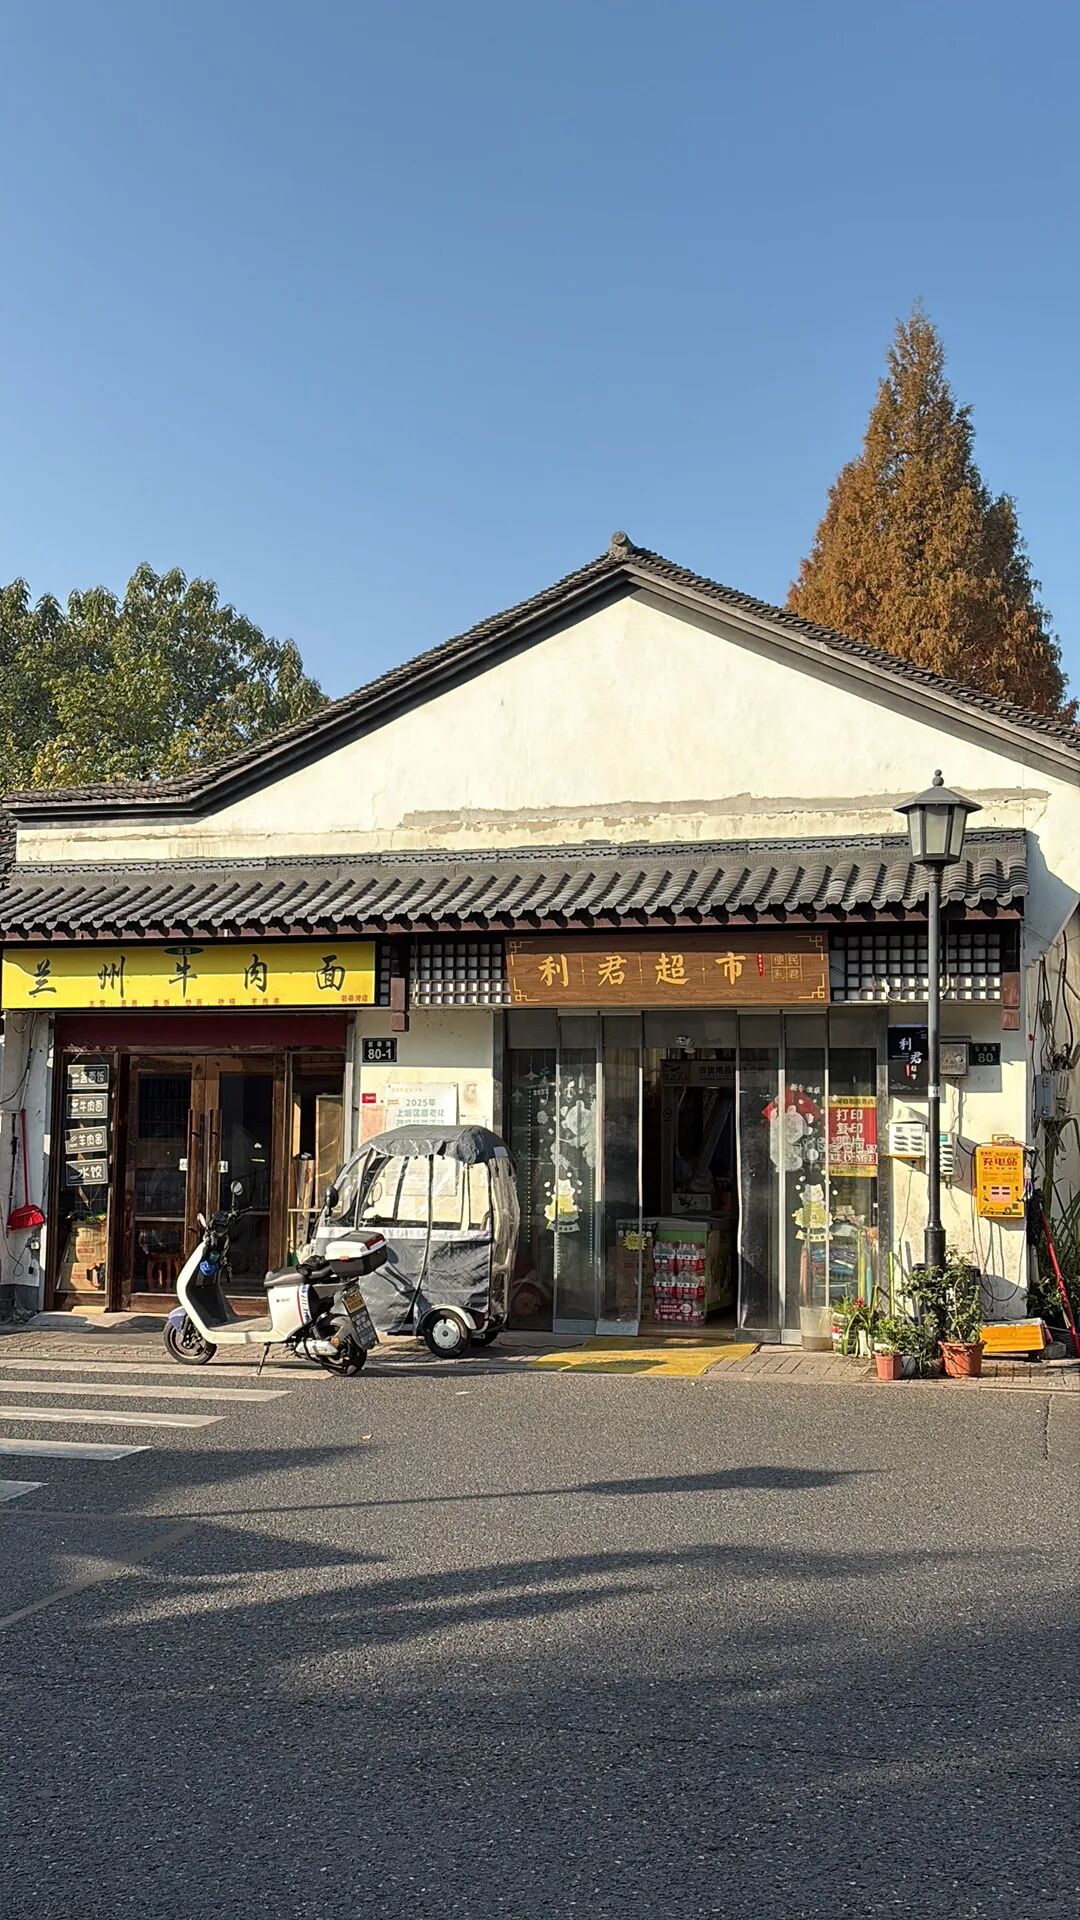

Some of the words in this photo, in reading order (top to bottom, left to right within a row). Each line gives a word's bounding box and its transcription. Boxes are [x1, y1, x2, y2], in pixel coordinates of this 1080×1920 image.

[774, 954, 799, 966] 便民
[28, 953, 346, 998] 兰州牛肉面
[538, 951, 747, 988] 利君超市
[774, 968, 799, 980] 利君
[367, 1048, 392, 1060] 80-1
[977, 1052, 994, 1063] 80
[79, 1099, 103, 1113] 牛肉面
[836, 1108, 863, 1122] 打印
[836, 1122, 863, 1135] 复印
[78, 1133, 103, 1147] 羊肉串
[983, 1157, 1018, 1167] 充电站
[78, 1165, 102, 1179] 水饺
